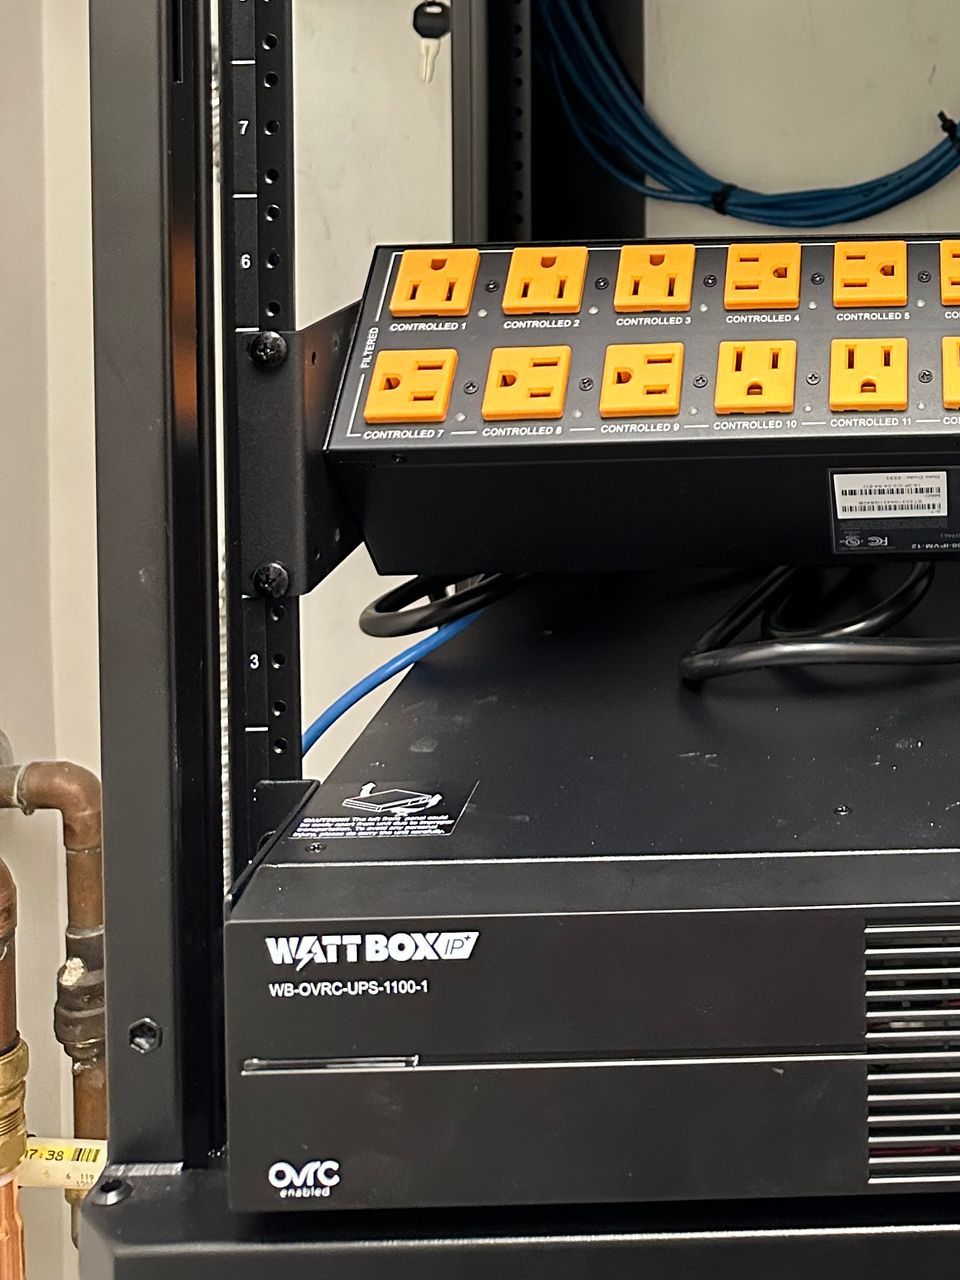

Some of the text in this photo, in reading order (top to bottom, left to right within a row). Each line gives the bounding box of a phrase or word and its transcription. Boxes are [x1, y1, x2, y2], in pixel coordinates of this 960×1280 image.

[239, 121, 248, 134] 7
[241, 254, 250, 268] 6
[390, 323, 457, 331] CONTROLLED
[503, 321, 566, 329] CONTROLLED
[361, 328, 379, 368] FILTERED
[714, 421, 782, 430] CONTROLLED
[830, 418, 898, 427] CONTROLLED
[482, 427, 551, 436] CONTROLLED
[601, 424, 670, 433] CONTROLLED
[363, 430, 434, 439] CONTROLLED
[250, 654, 259, 669] 3
[268, 980, 428, 997] WB-OVRC-UPS-1100-1
[280, 1187, 330, 1198] enabled
